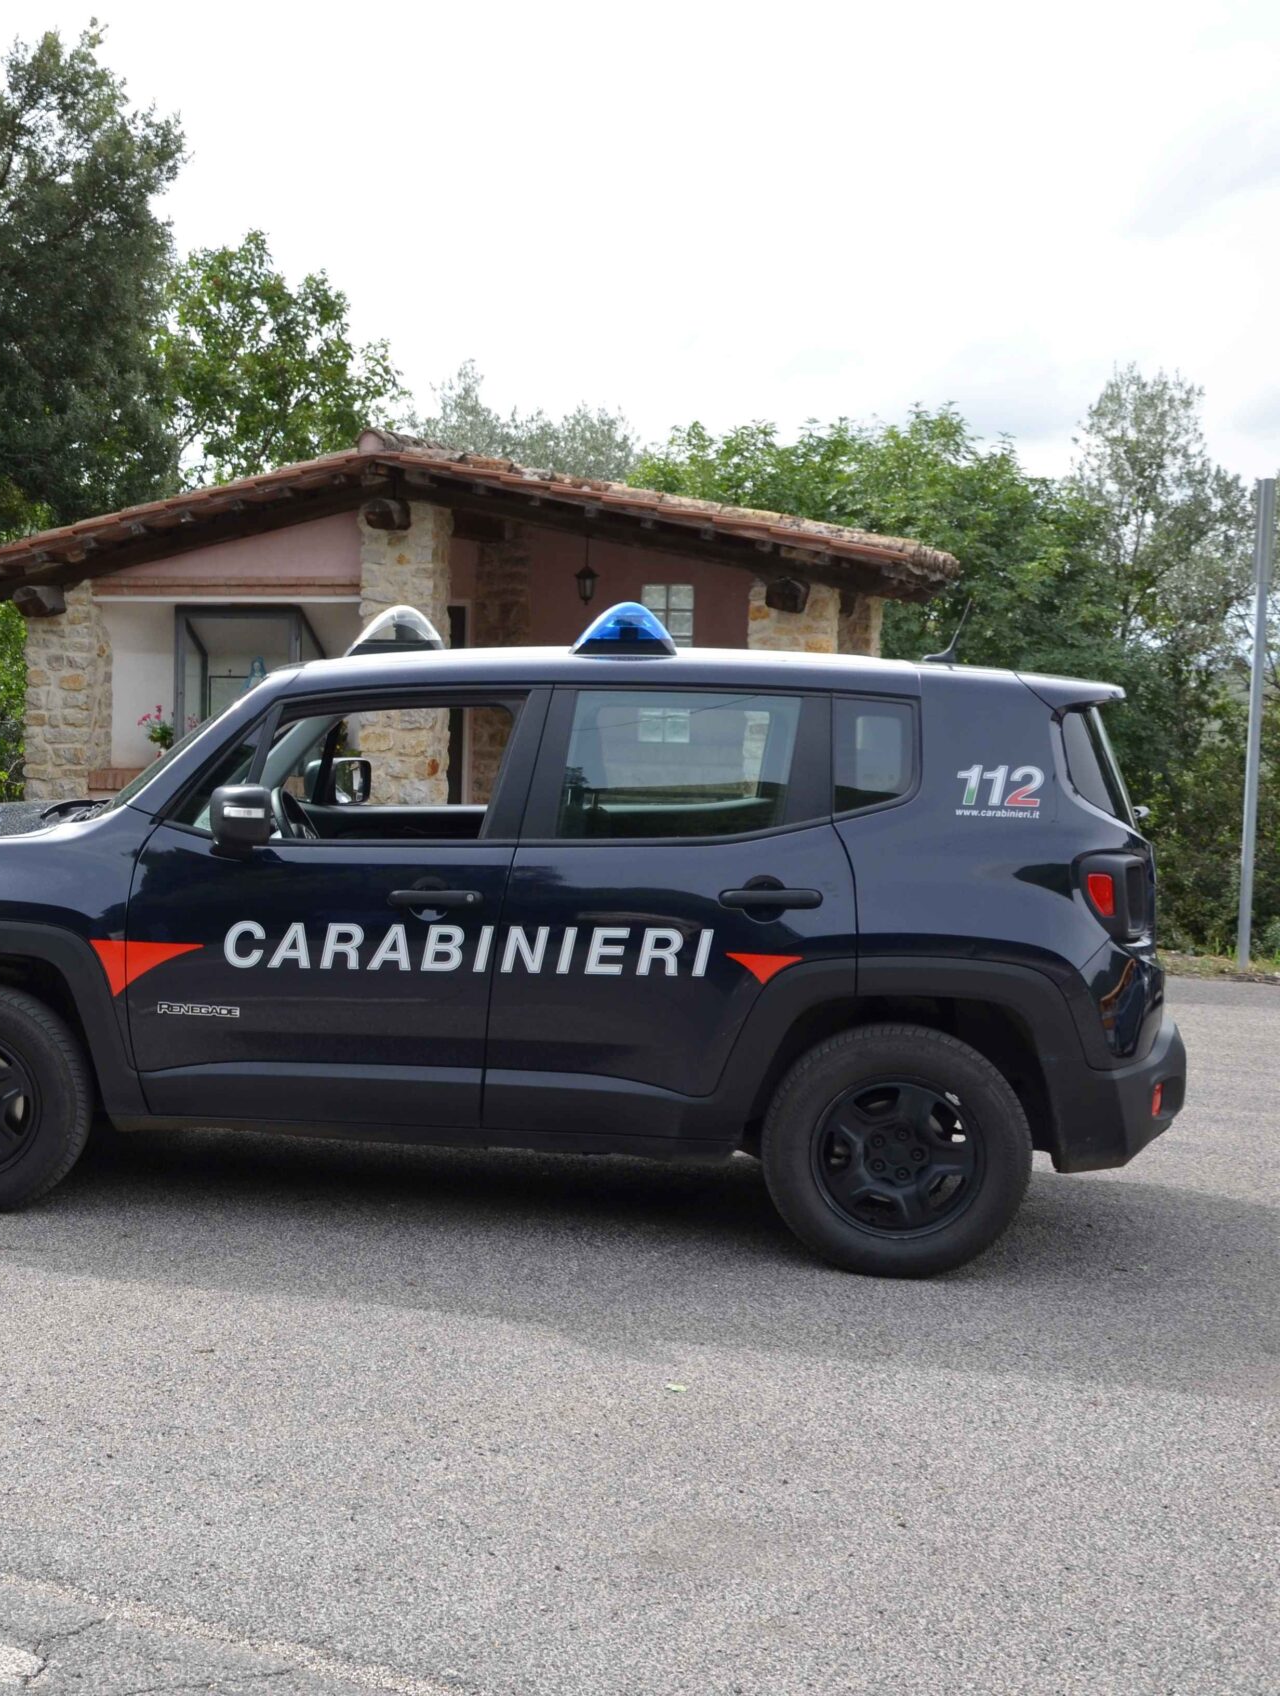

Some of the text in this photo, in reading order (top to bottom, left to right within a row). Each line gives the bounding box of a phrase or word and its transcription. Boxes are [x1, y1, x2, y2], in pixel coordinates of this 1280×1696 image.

[957, 764, 1045, 807] 112
[955, 808, 1040, 819] www.carabinieri.it
[223, 920, 715, 977] CARABINIERI
[157, 1001, 240, 1018] RENEGADE
